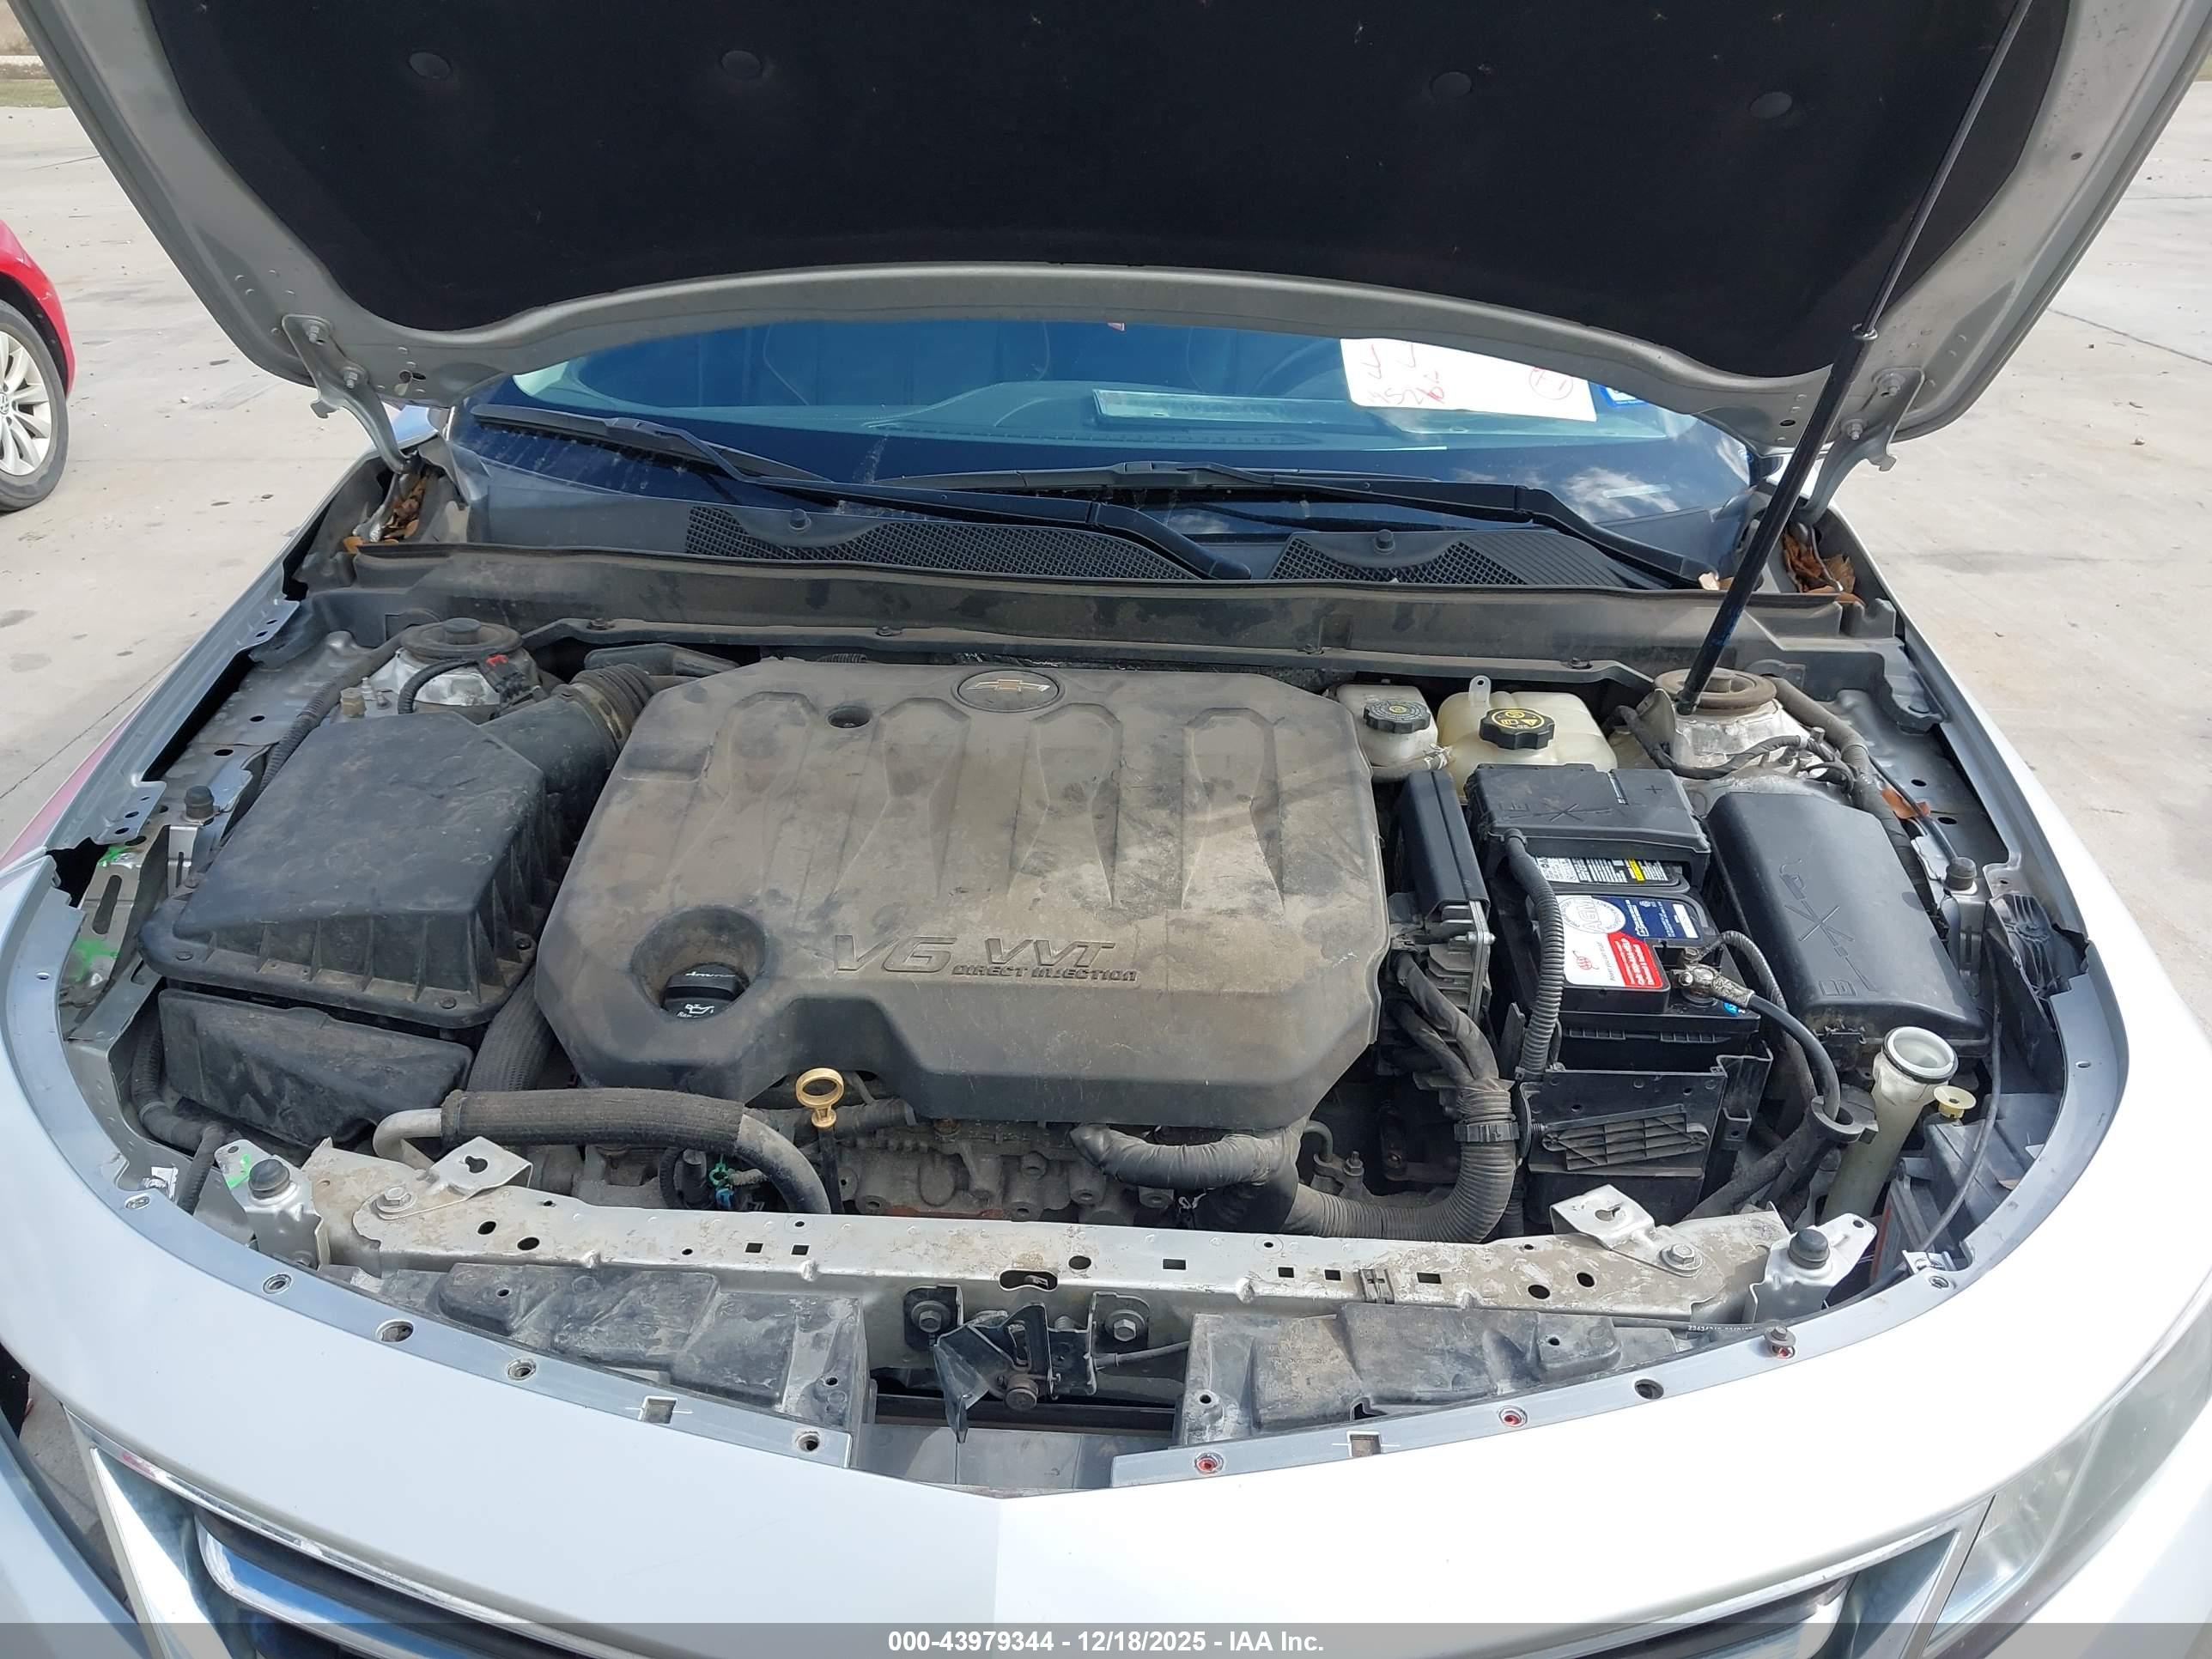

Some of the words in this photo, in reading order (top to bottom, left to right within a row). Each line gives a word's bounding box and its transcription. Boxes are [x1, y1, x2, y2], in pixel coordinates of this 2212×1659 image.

[835, 934, 957, 972] V6
[985, 938, 1115, 967] VVT
[951, 964, 1028, 976] DIRECT
[1031, 968, 1138, 981] INJECTION
